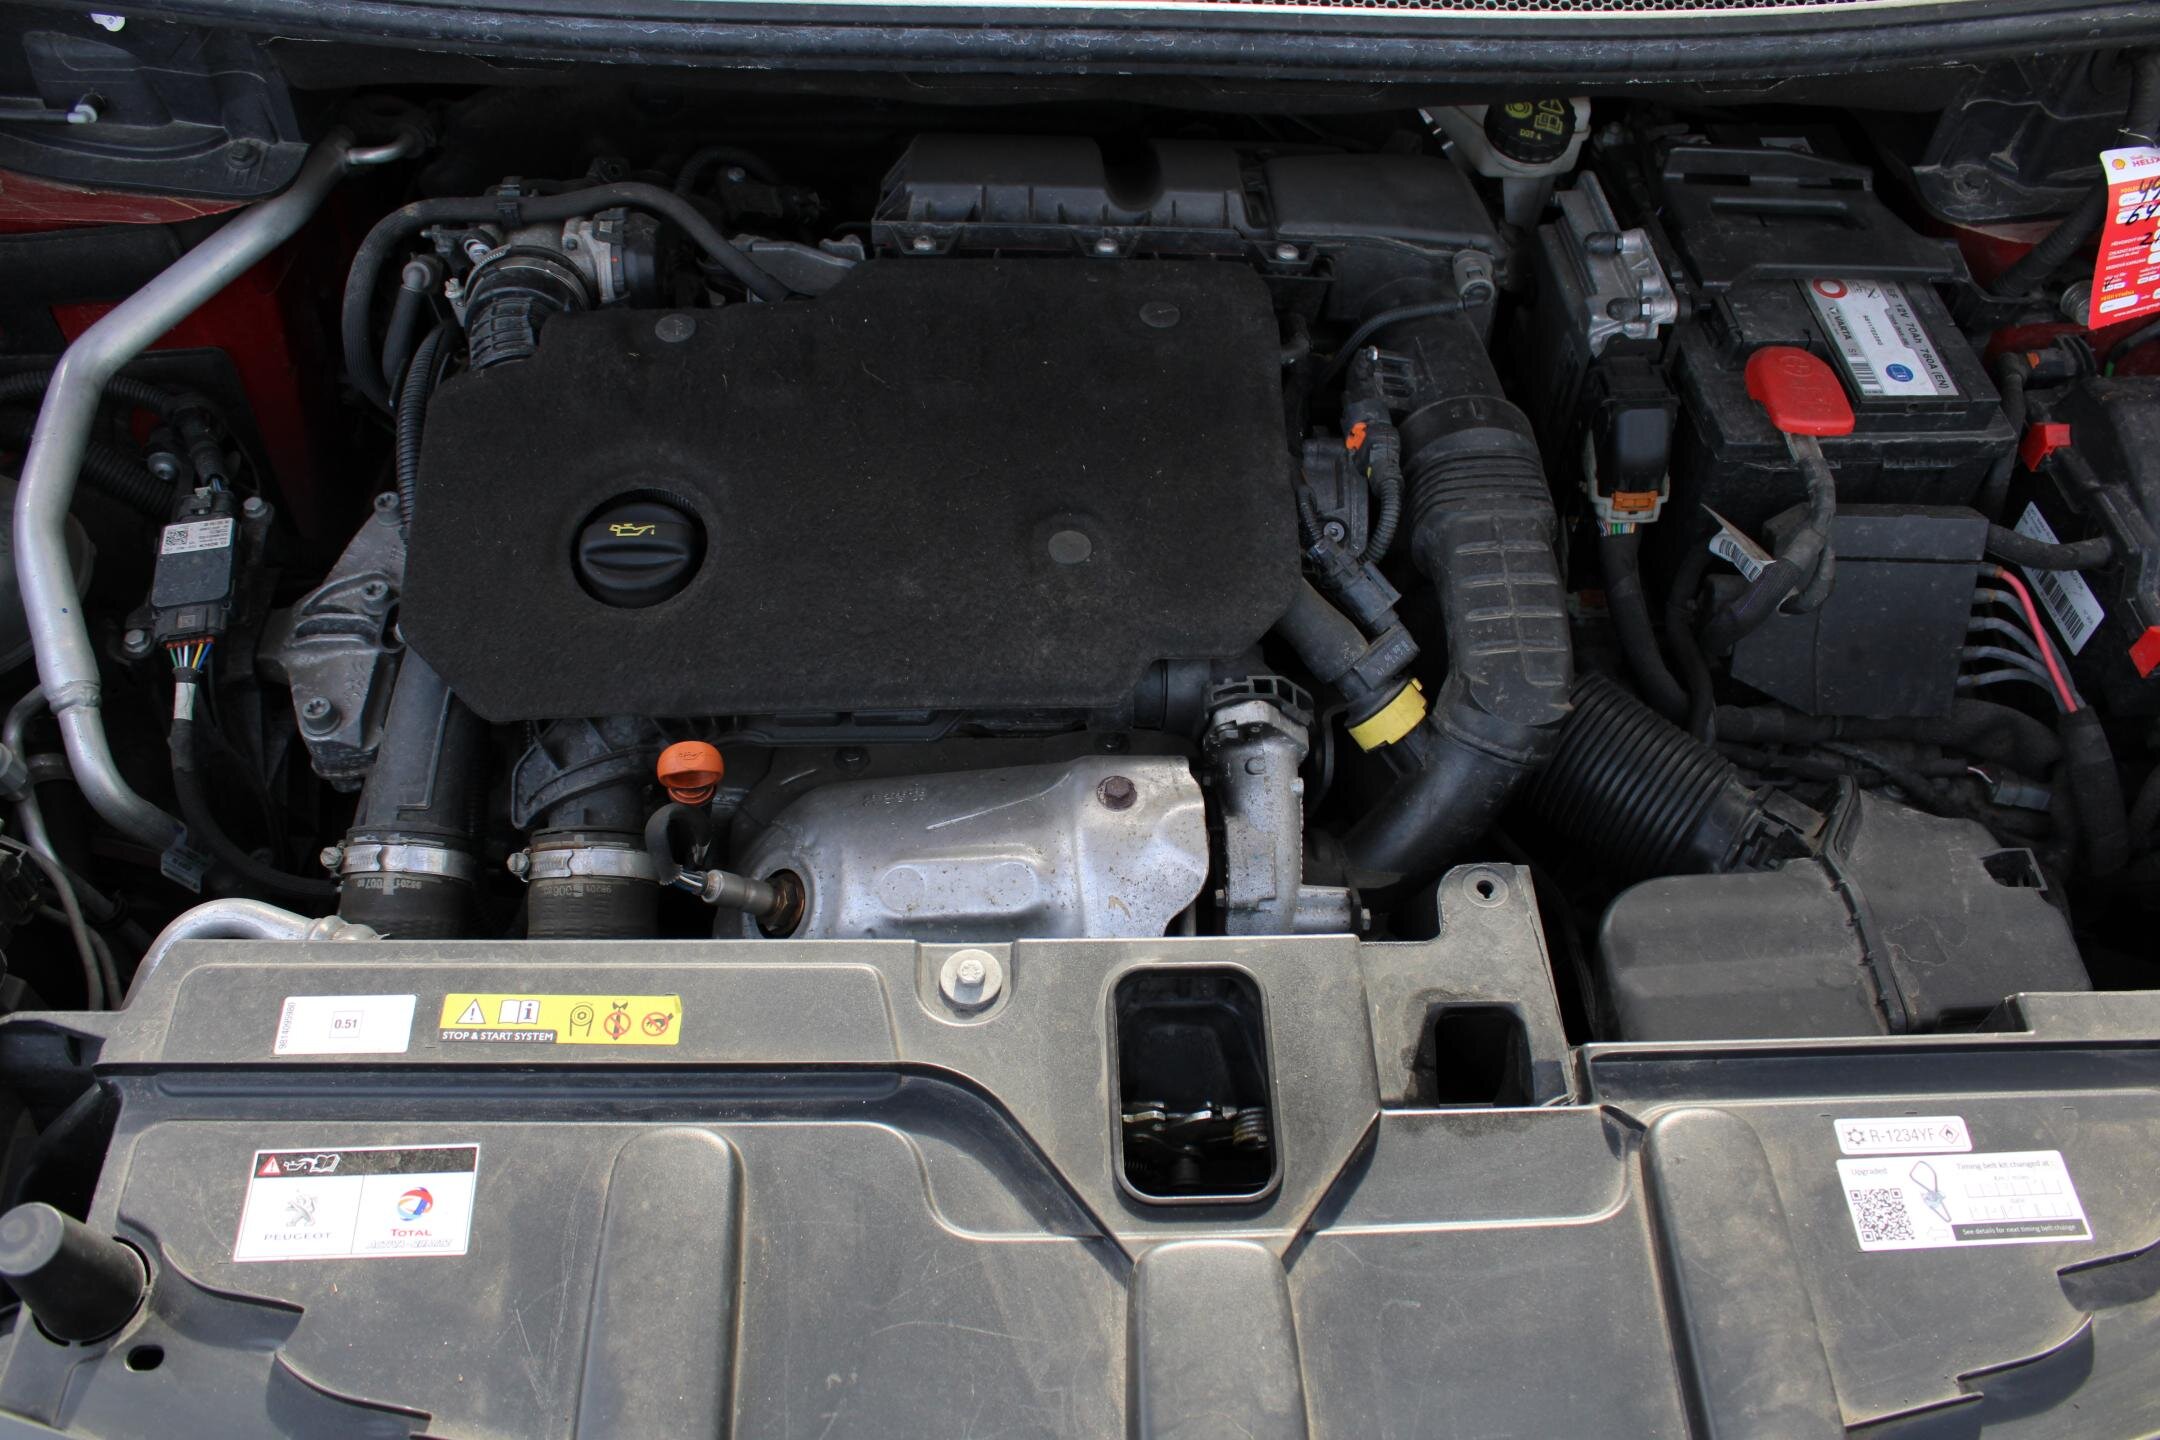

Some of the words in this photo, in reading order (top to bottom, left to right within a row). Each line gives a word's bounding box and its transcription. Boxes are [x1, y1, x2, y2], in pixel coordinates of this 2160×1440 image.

[1520, 128, 1535, 138] DOT
[1835, 314, 1852, 340] VARTA
[1895, 304, 1909, 318] 12V
[1905, 321, 1922, 344] 70Ah
[1920, 348, 1937, 369] 760A
[1932, 371, 1949, 389] (EN)
[334, 1019, 358, 1029] 0.51
[442, 1031, 469, 1040] STOP
[470, 1031, 479, 1040] &
[480, 1031, 512, 1040] START
[513, 1032, 554, 1041] SYSTEM
[1869, 1128, 1935, 1143] R-1234YF
[1983, 1161, 1998, 1169] belt
[1851, 1168, 1887, 1176] Upgraded
[391, 1228, 432, 1237] TOTAL
[1975, 1227, 1995, 1235] details
[2020, 1225, 2041, 1233] timing
[264, 1232, 333, 1241] PEUGEOT
